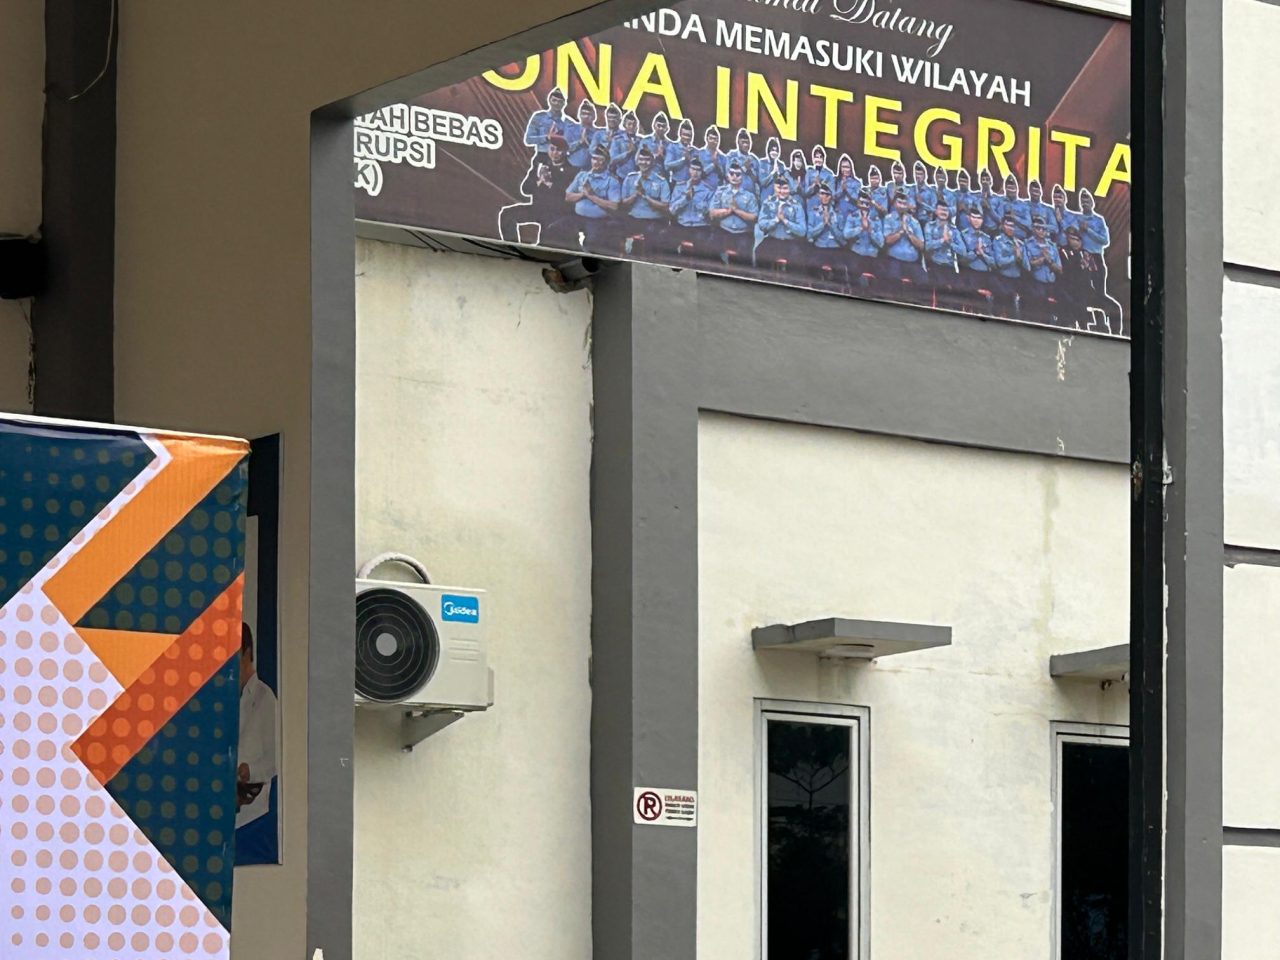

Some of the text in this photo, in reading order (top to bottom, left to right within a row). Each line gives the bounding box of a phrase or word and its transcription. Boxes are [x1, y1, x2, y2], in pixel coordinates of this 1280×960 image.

[623, 8, 1032, 108] NDA MEMASUKI WILAYAH
[354, 128, 435, 169] RUPSI
[410, 106, 503, 149] BEBAS
